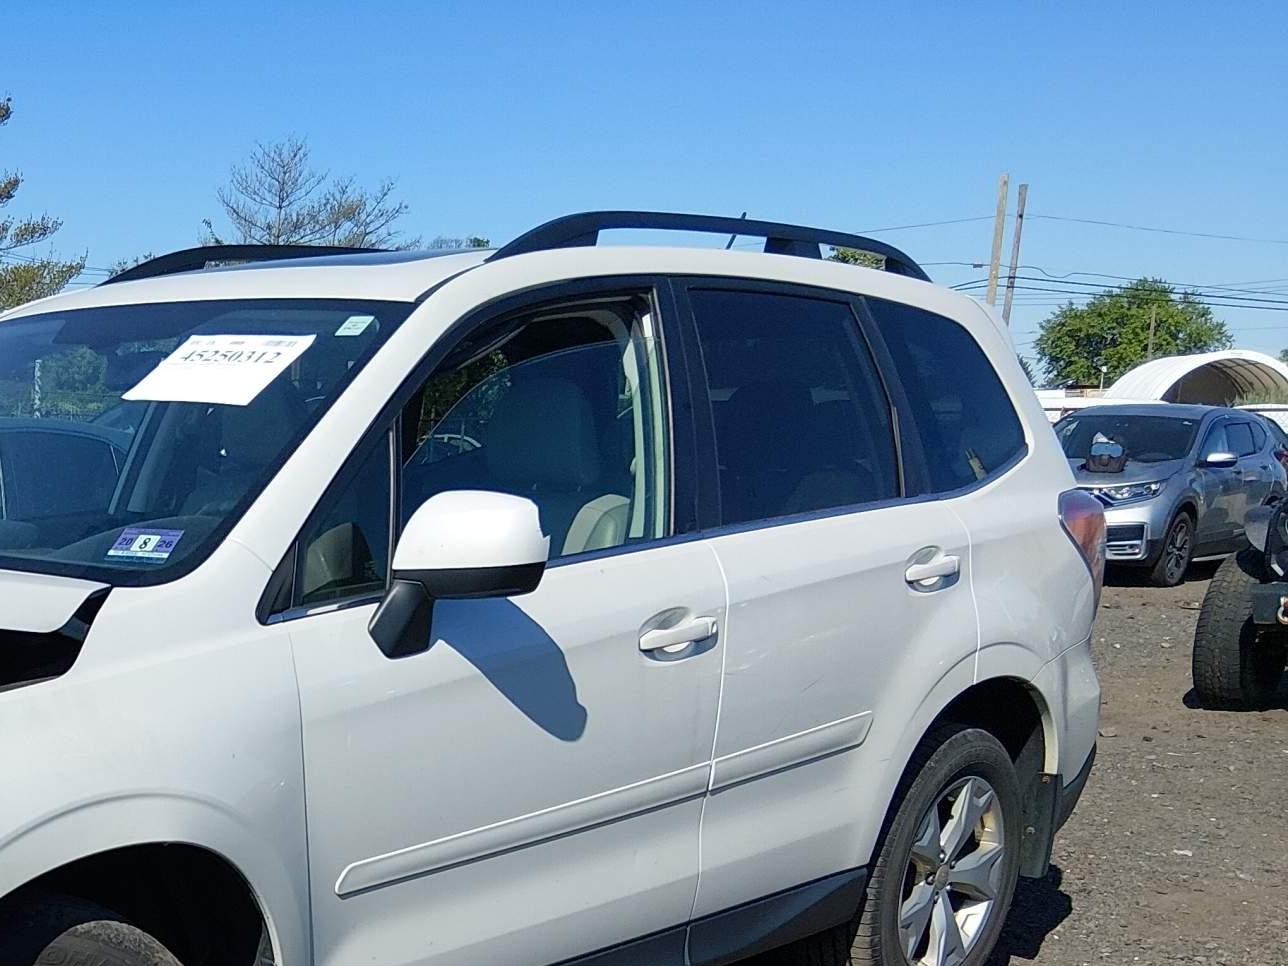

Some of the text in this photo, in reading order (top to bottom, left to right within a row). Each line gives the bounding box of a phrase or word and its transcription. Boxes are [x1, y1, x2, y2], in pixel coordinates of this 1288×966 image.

[180, 350, 283, 364] 45250312
[118, 537, 174, 549] 20 8 26
